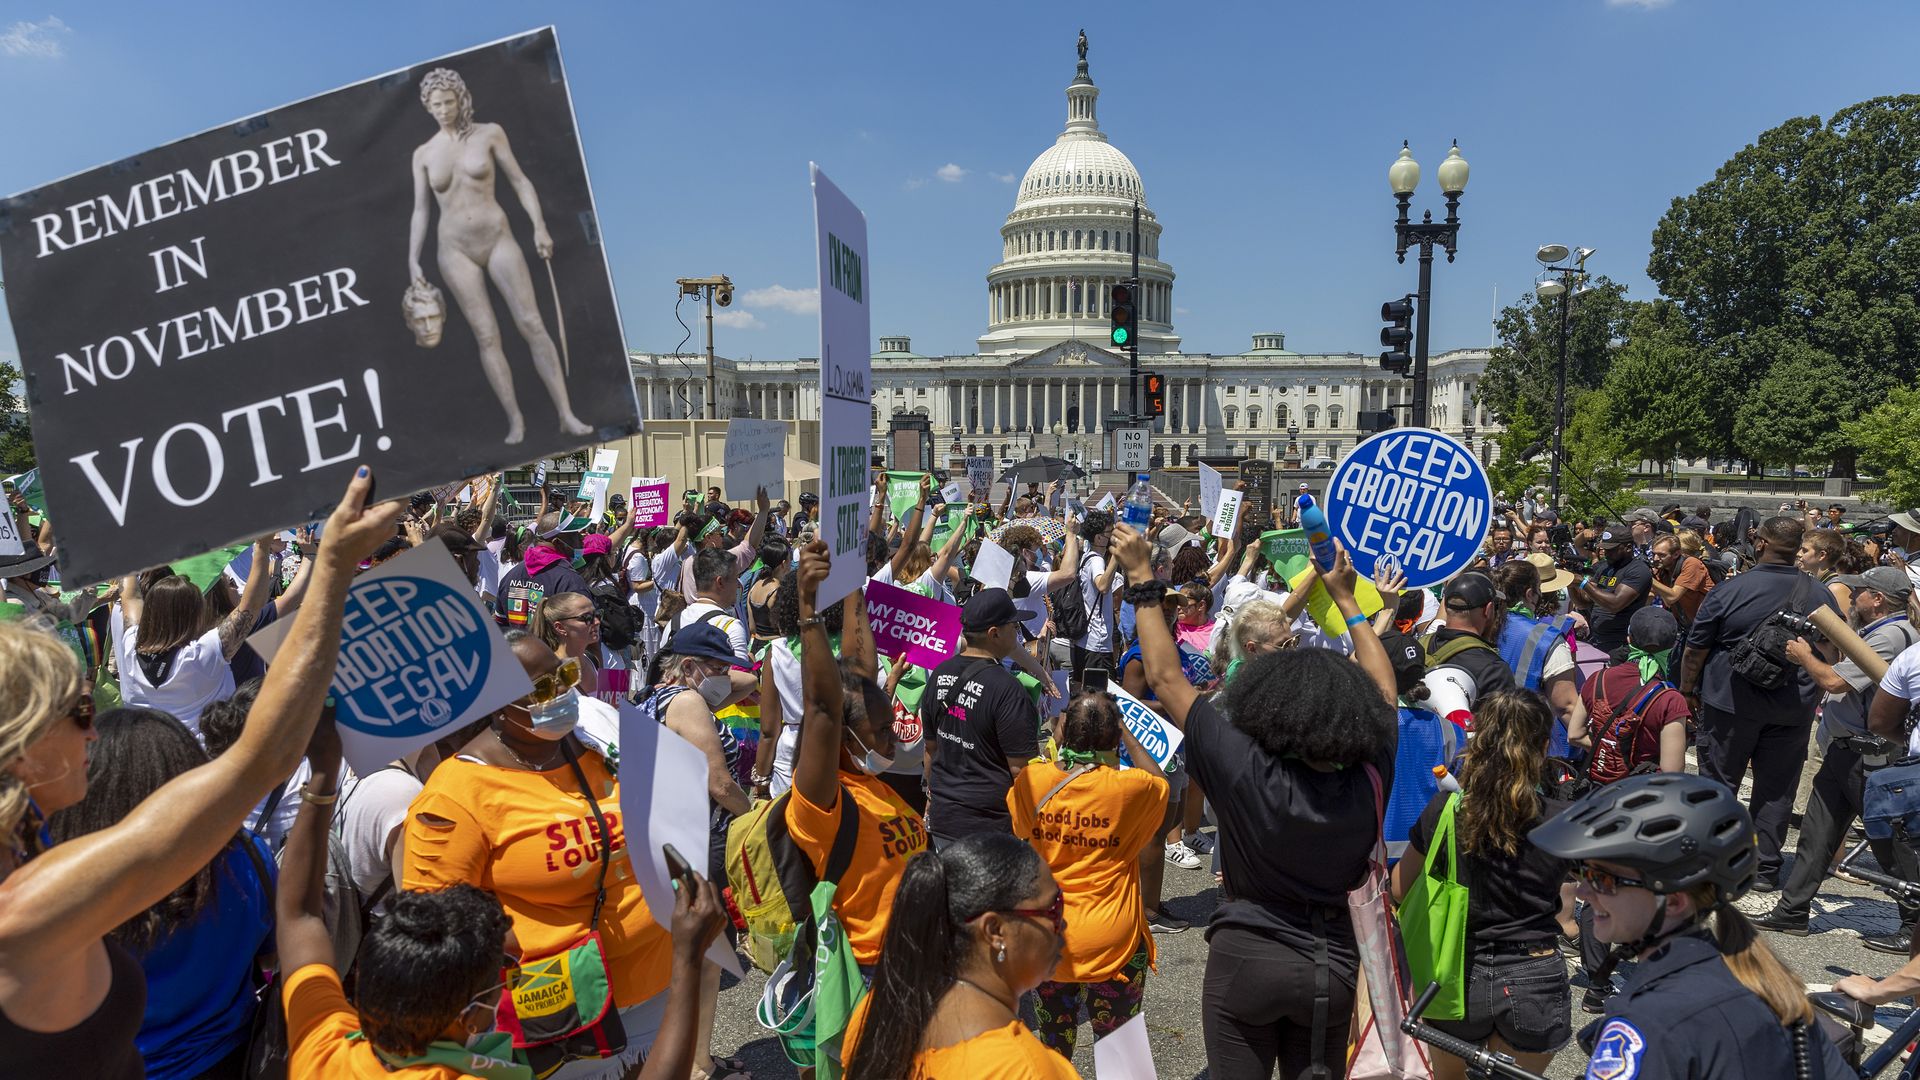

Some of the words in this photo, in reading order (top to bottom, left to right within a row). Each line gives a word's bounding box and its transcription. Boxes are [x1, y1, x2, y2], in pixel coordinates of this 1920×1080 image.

[31, 128, 341, 259] REMEMBER
[147, 236, 209, 294] IN
[829, 231, 843, 292] I'M
[842, 242, 863, 305] FROM
[55, 266, 370, 396] NOVEMBER
[1154, 399, 1162, 412] 5
[69, 367, 393, 527] VOTE!
[1123, 442, 1143, 450] TURN
[1125, 432, 1141, 440] NO
[829, 446, 836, 499] A
[836, 446, 867, 494] TRIGGER
[1125, 460, 1140, 468] RED
[1374, 434, 1472, 487] KEEP
[1219, 502, 1230, 524] STATE
[1223, 503, 1236, 532] TRIGGER
[1336, 461, 1484, 541] ABORTION
[836, 502, 860, 557] STATE
[1340, 505, 1455, 571] LEGAL
[510, 580, 545, 592] NAUTICA
[343, 580, 418, 640] EEP
[867, 600, 894, 619] MY
[894, 609, 938, 636] BODY,
[890, 624, 948, 654] CHOICE.
[345, 646, 480, 727] LEGAL
[963, 694, 977, 710] AT
[1116, 698, 1162, 733] KEEP
[545, 810, 618, 851] STEP
[1072, 812, 1110, 830] jobs
[1062, 832, 1120, 849] schools
[517, 981, 568, 1005] JAMAICA
[525, 1003, 535, 1012] NO
[535, 992, 567, 1011] PROBLEM
